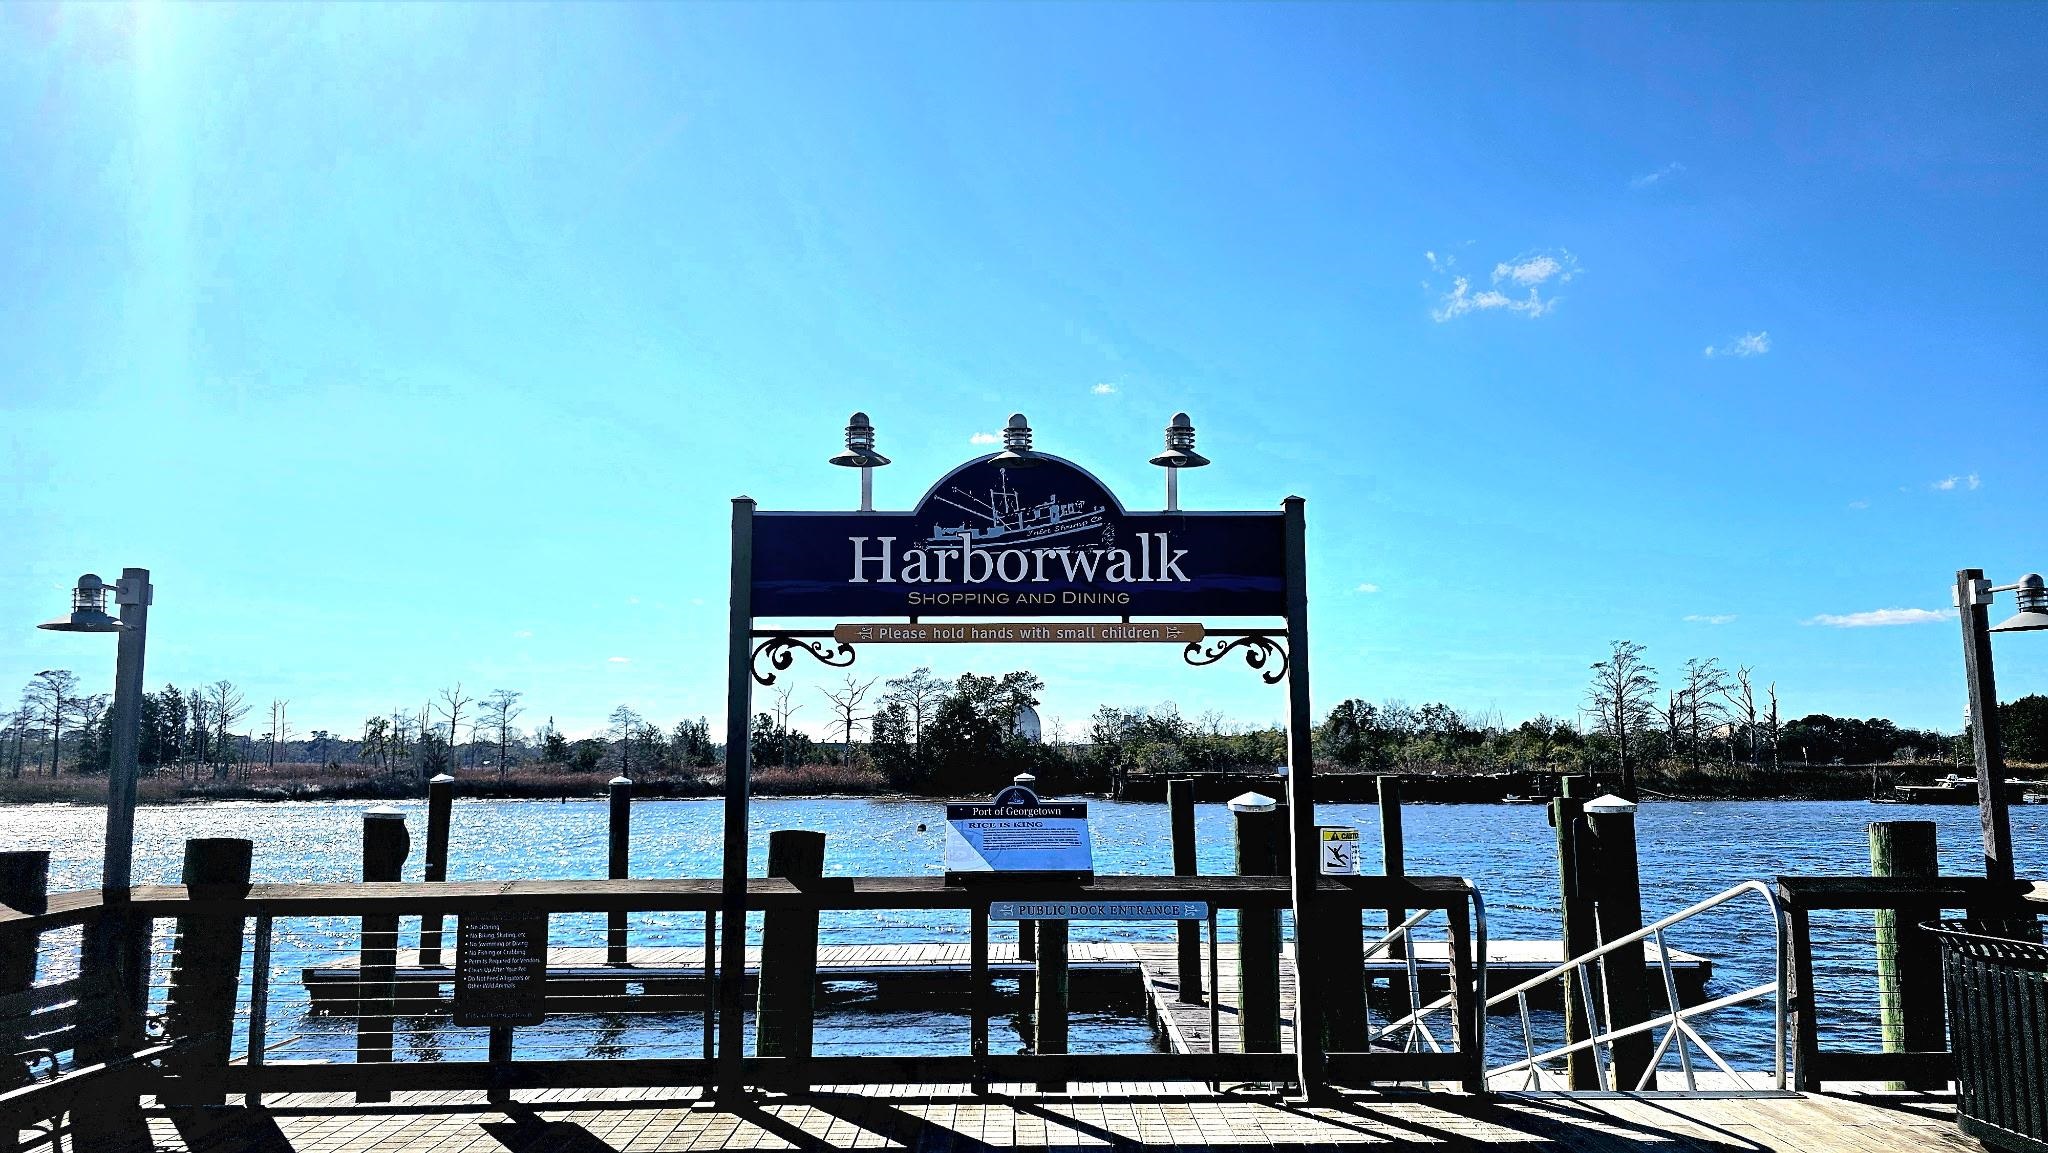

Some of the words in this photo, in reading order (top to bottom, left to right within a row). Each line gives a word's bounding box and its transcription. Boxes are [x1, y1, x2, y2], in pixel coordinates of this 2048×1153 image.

[849, 532, 1191, 583] Harborwalk
[908, 591, 1009, 604] SHOPPING
[1062, 591, 1130, 604] DINING
[879, 628, 926, 639] Please
[933, 627, 964, 639] hold
[971, 627, 1013, 639] hands
[1019, 627, 1051, 638] with
[1057, 627, 1095, 638] small
[1102, 627, 1159, 638] children
[973, 807, 992, 815] Port
[994, 807, 1004, 815] of
[1006, 807, 1061, 817] Georgetown
[1019, 906, 1066, 915] PUBLIC
[1070, 906, 1105, 915] DOCK
[1110, 906, 1180, 915] ENTRANCE
